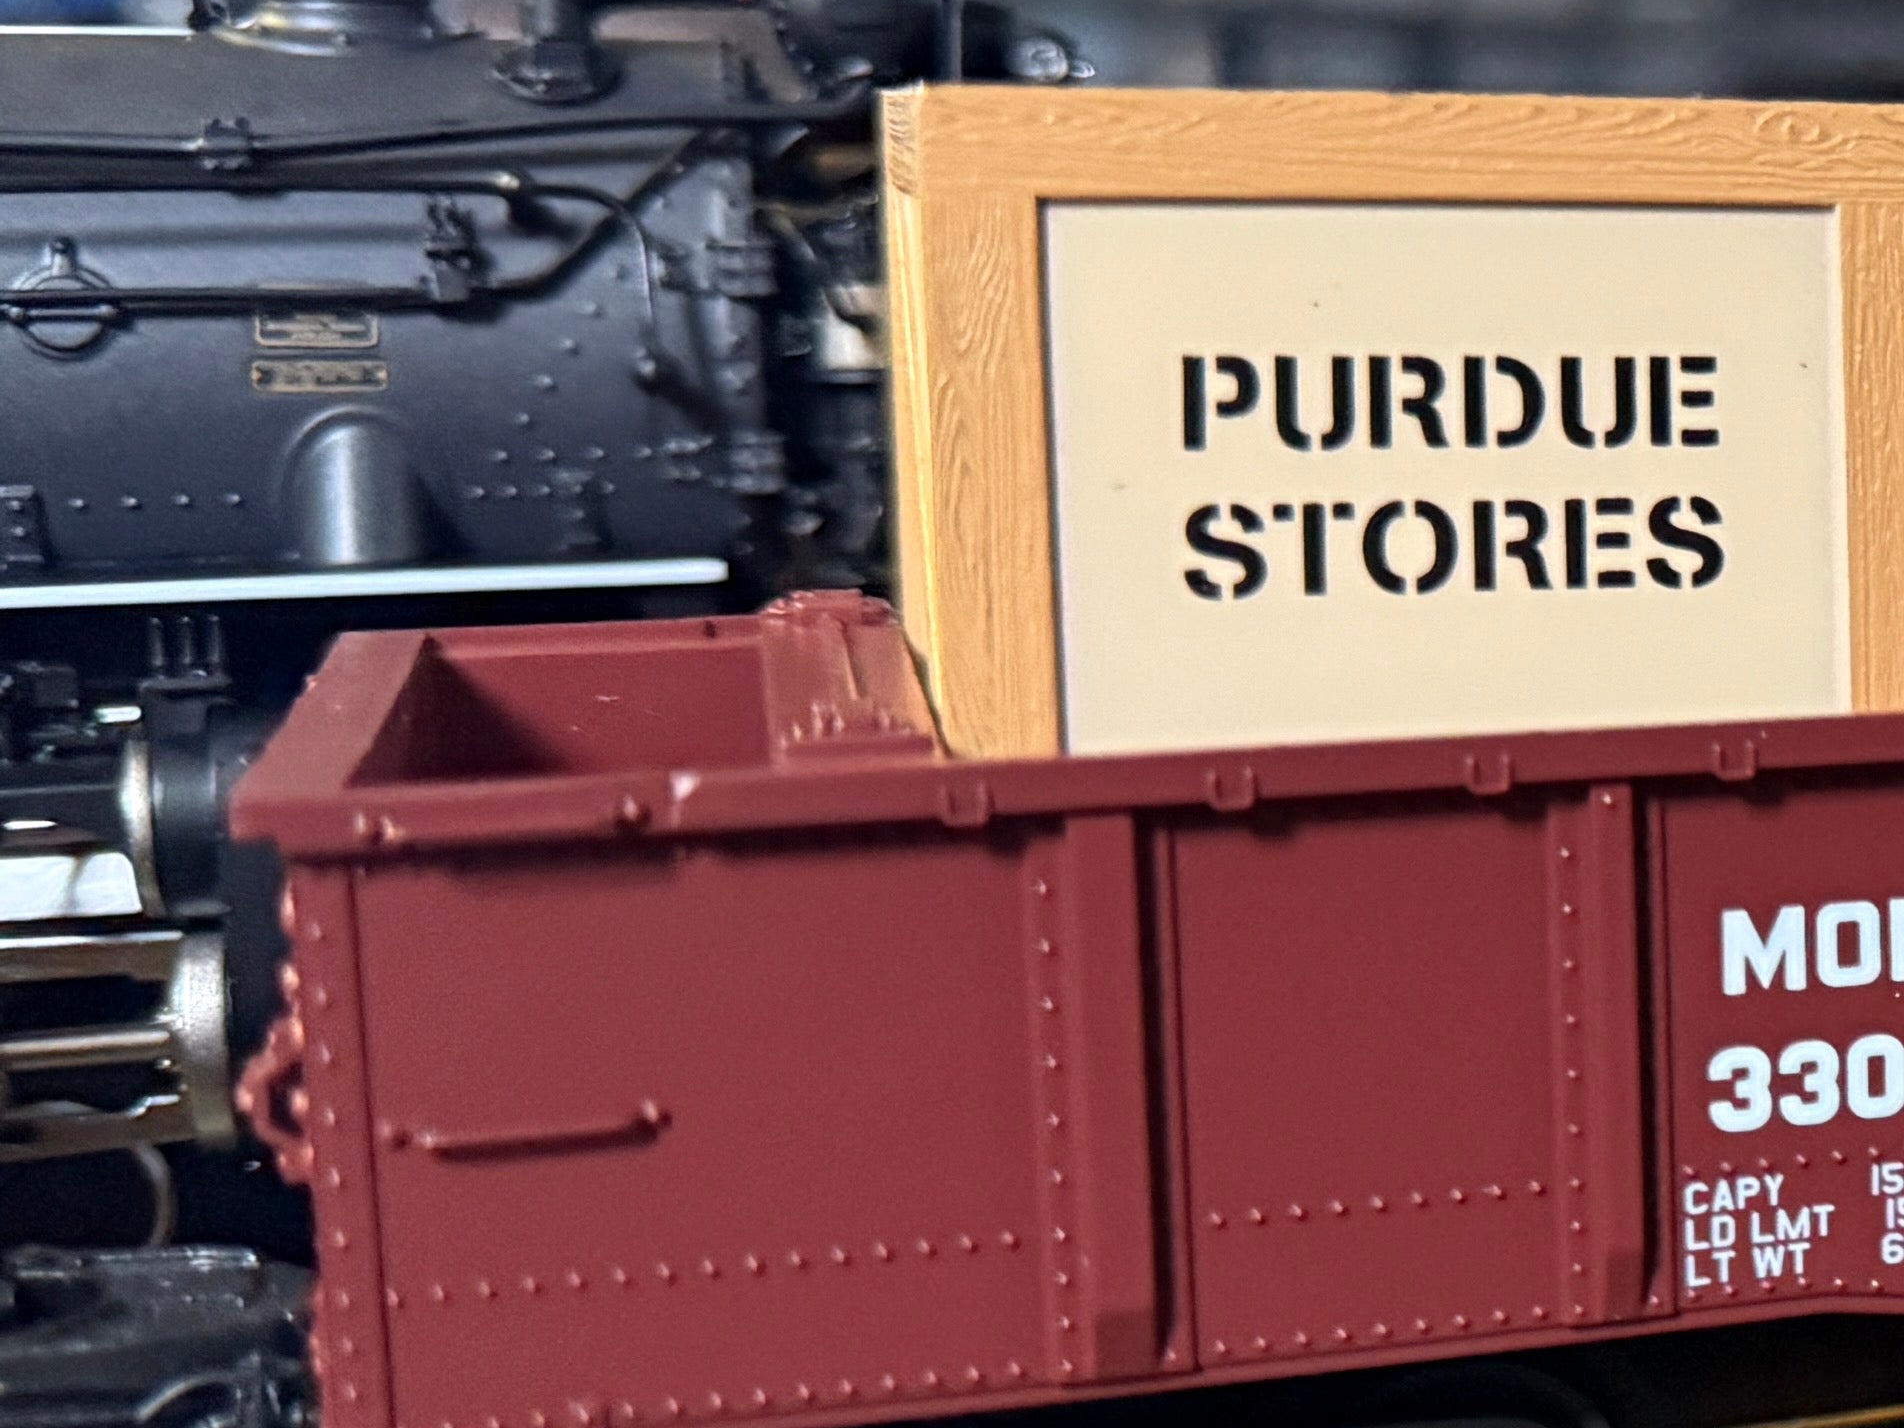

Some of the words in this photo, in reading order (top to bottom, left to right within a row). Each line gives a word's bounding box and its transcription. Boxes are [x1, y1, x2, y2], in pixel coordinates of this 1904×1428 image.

[1181, 354, 1720, 452] PURDUE
[1183, 494, 1725, 601] STORES
[1682, 1172, 1784, 1215] CAPY
[1683, 1213, 1737, 1251] LD
[1750, 1204, 1836, 1245] LMT
[1684, 1250, 1737, 1287] LT
[1752, 1241, 1811, 1279] WT
